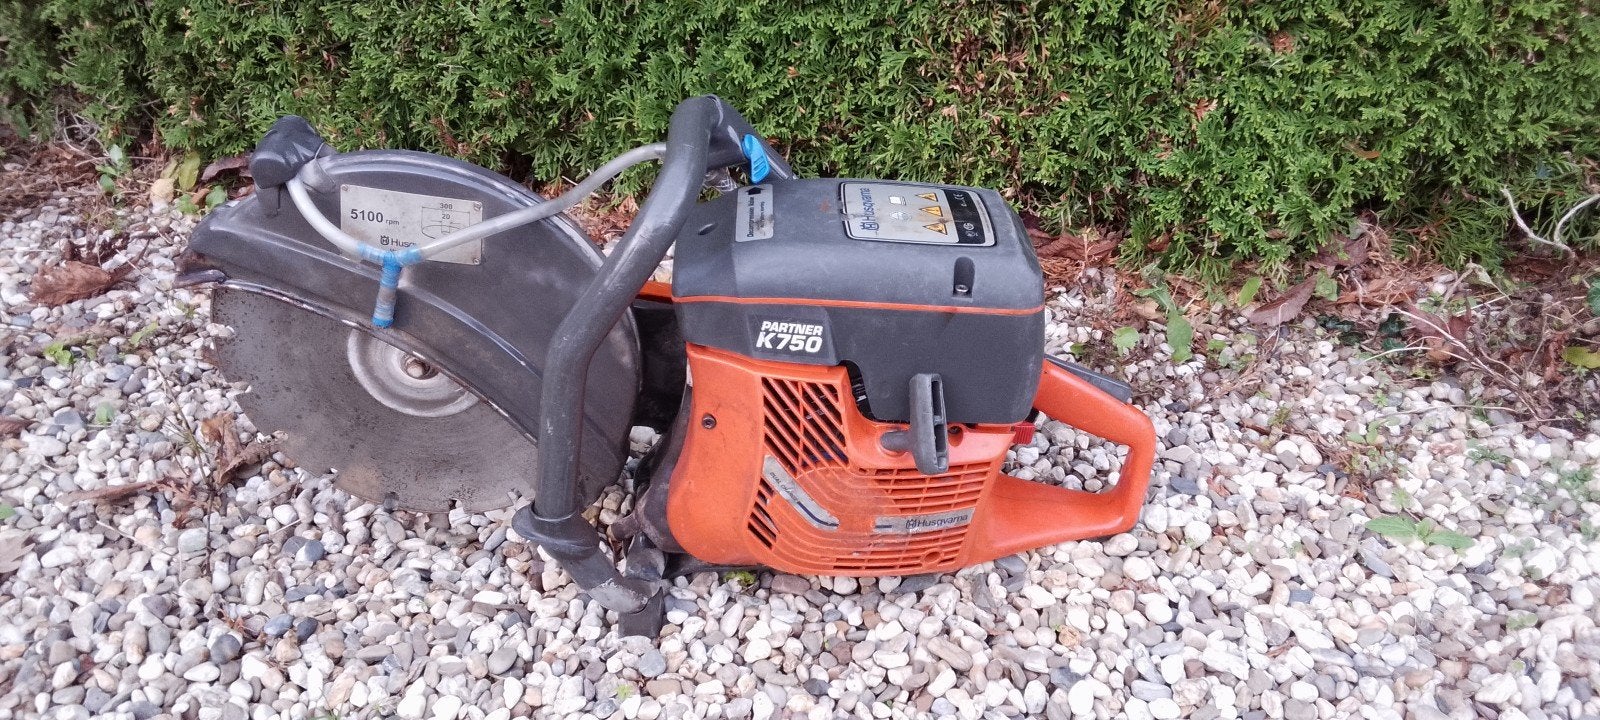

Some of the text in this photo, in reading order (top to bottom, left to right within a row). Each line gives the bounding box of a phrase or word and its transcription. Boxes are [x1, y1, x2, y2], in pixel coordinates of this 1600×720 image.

[860, 187, 874, 221] Husqvarna
[351, 209, 384, 223] 5100
[761, 321, 823, 335] PARTNER
[917, 515, 968, 528] Husqvarna
